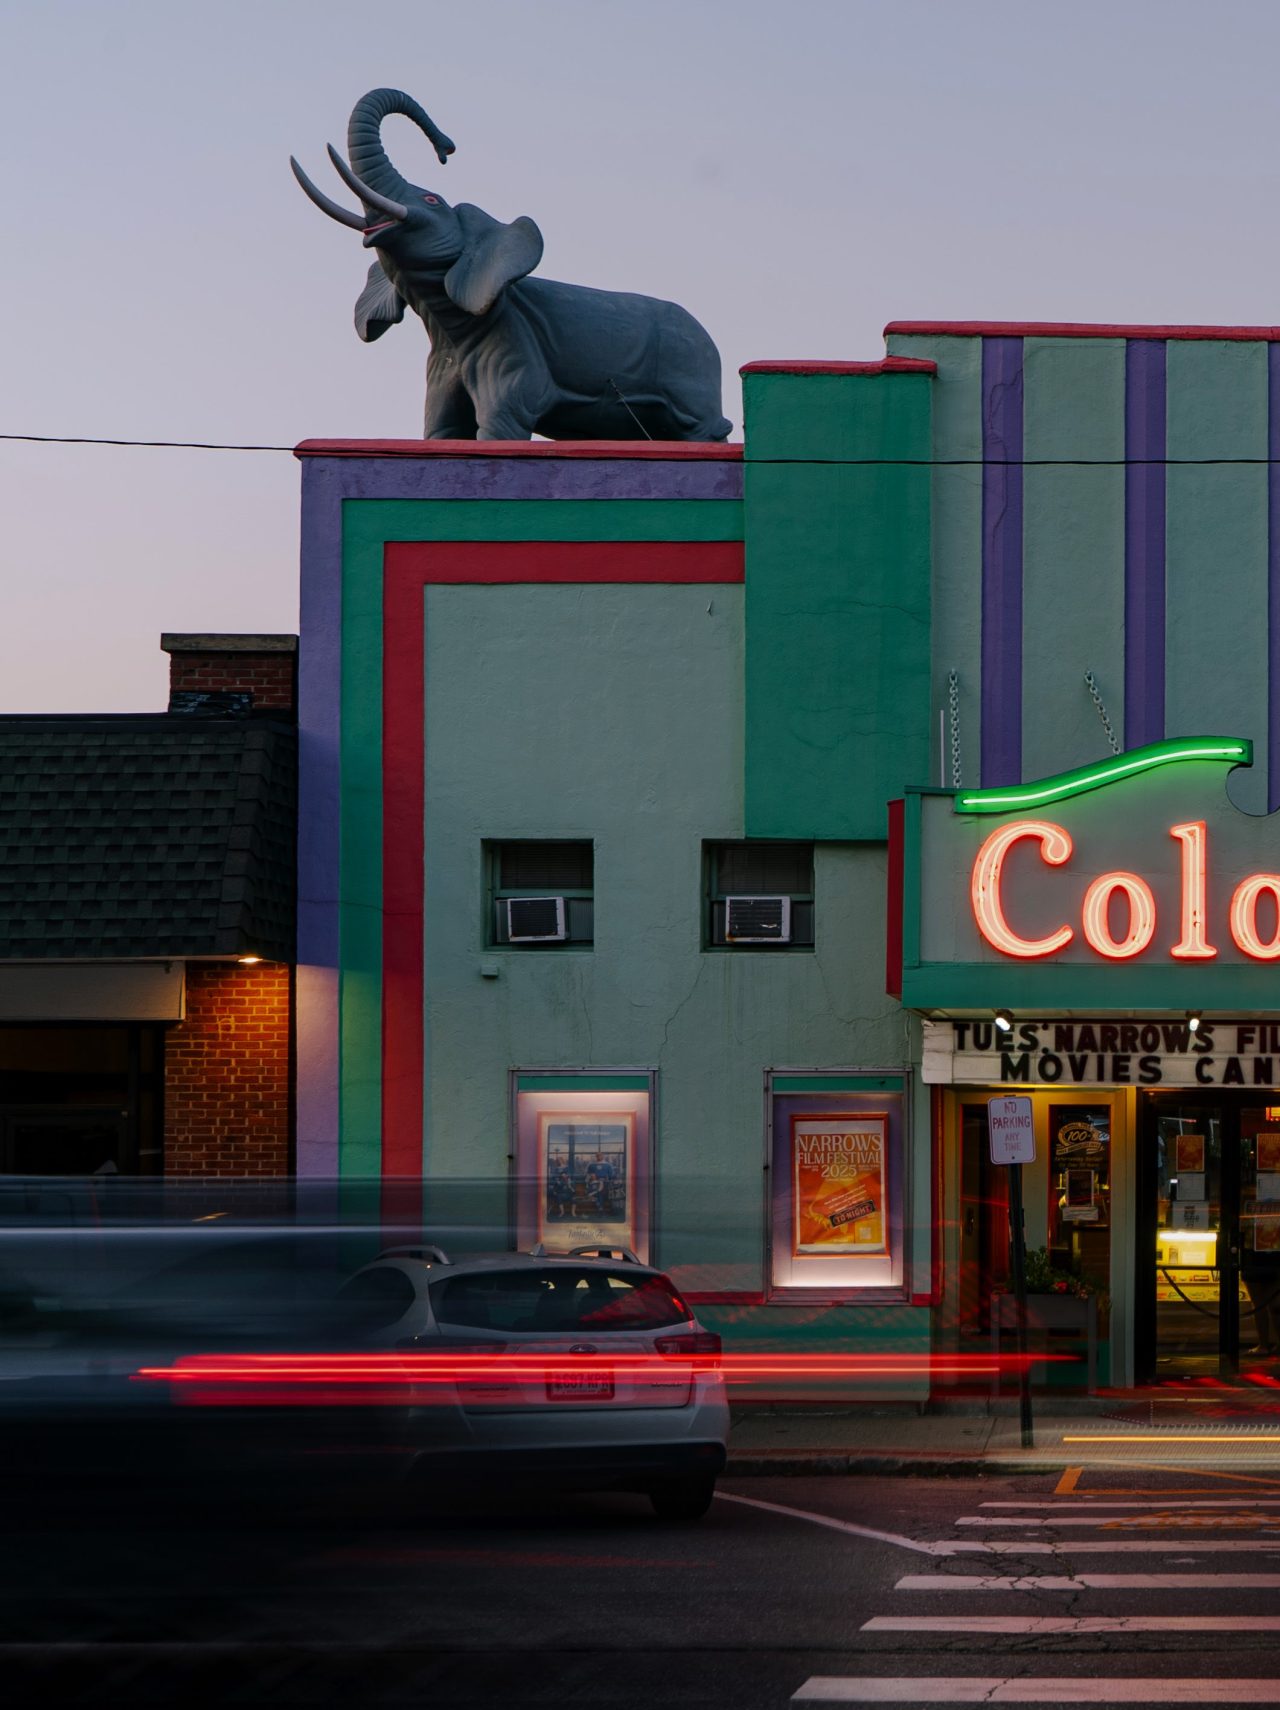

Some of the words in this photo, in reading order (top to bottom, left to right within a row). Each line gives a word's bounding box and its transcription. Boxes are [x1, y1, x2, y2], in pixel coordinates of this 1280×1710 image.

[1055, 1025, 1215, 1053] NARROWS
[1000, 1052, 1163, 1084] MOVIES
[1004, 1102, 1017, 1113] NO
[992, 1116, 1031, 1130] PARKING
[798, 1135, 881, 1152] NARROWS
[798, 1152, 824, 1165] FILM
[827, 1152, 881, 1165] FESTIVAL
[820, 1164, 857, 1178] 2025
